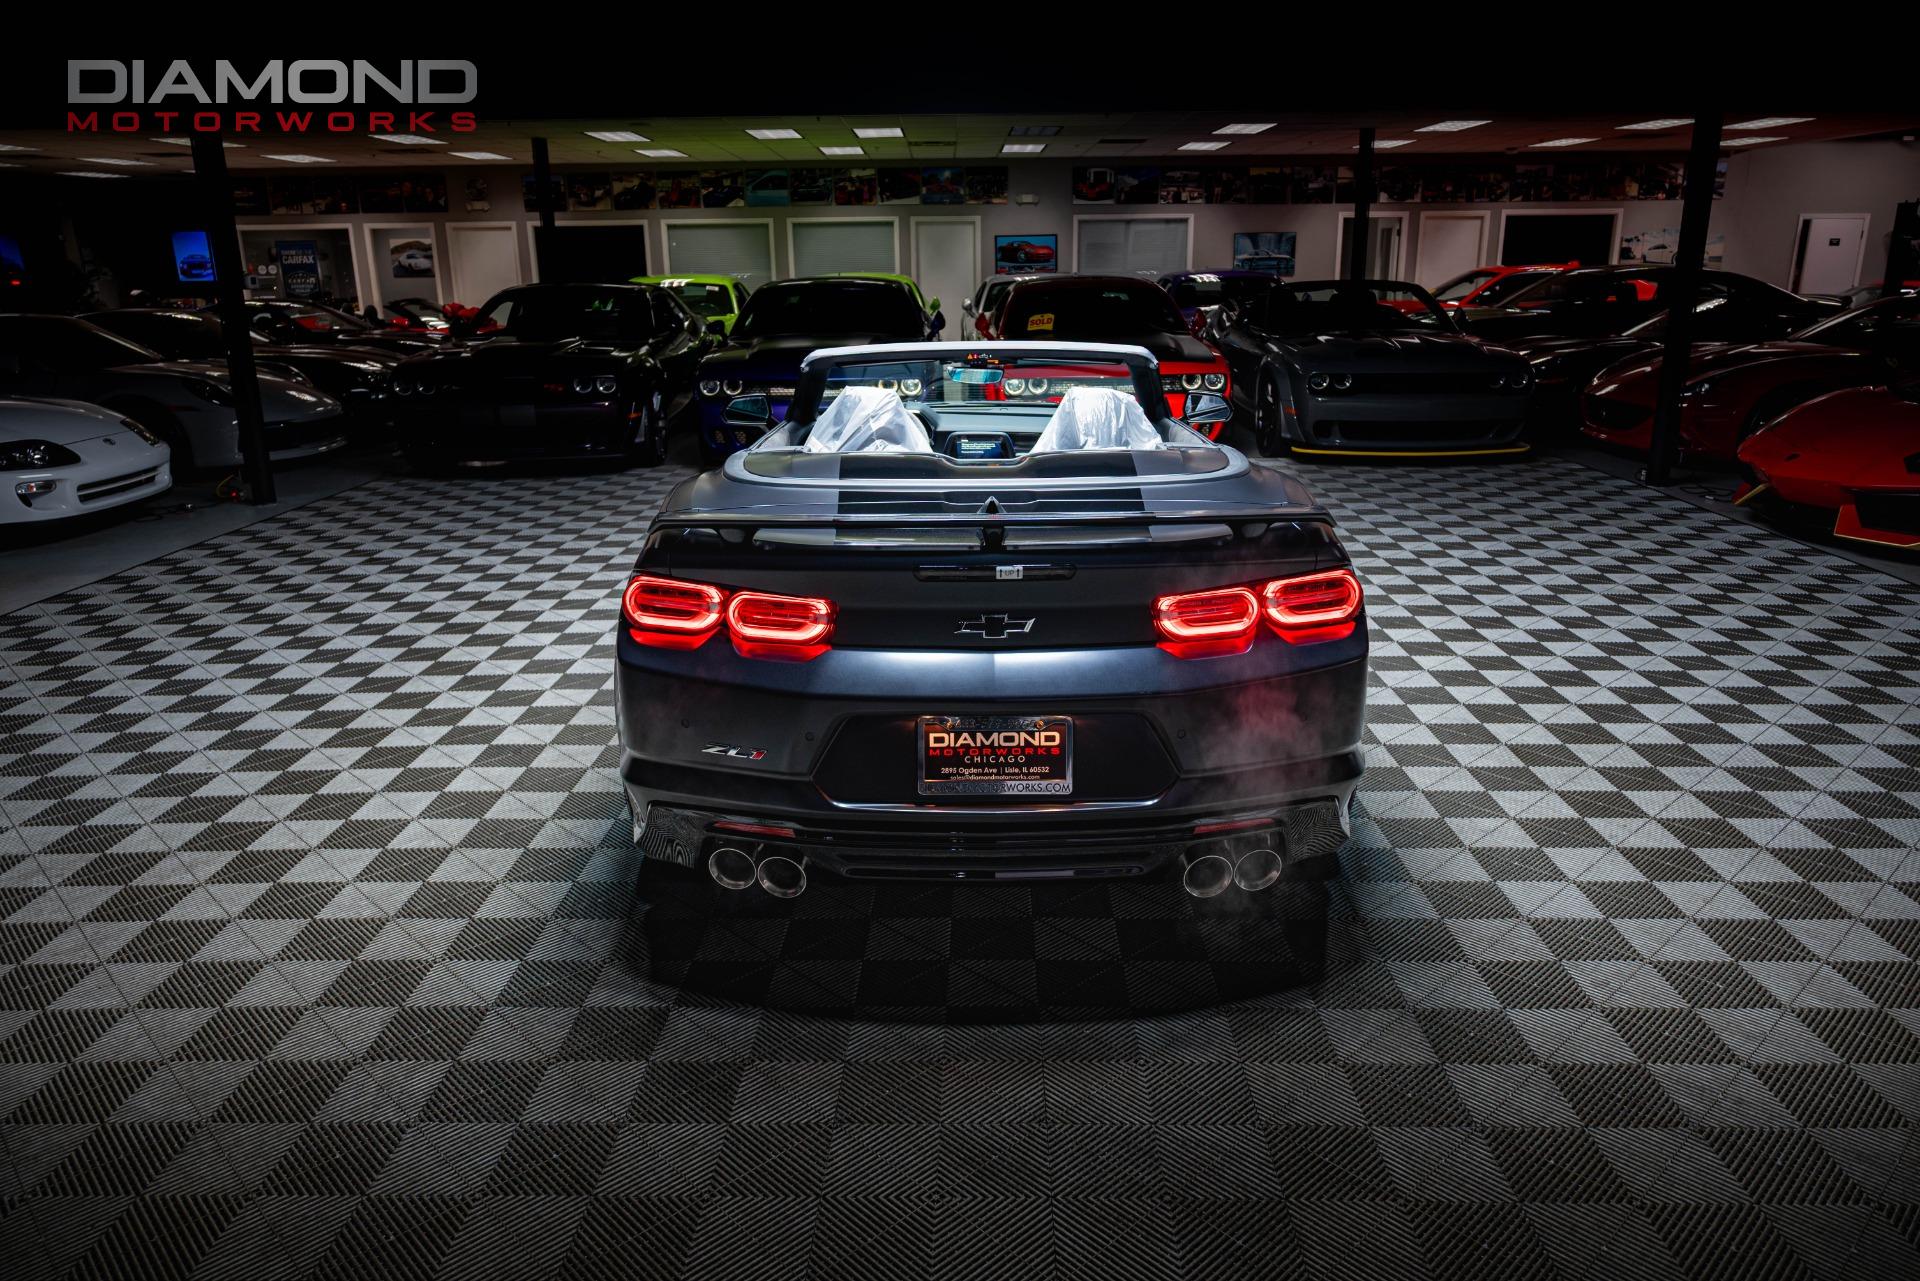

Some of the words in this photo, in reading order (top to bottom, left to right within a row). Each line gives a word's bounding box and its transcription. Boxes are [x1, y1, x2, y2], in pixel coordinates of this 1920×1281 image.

[282, 255, 314, 264] CARFAX
[1030, 317, 1053, 326] SOLD
[929, 731, 1060, 747] DIAMOND
[701, 742, 768, 760] ZL1
[929, 748, 1060, 756] MOTORWORKS
[964, 755, 1026, 764] CHICAGO
[958, 767, 982, 775] Ogden
[1004, 766, 1021, 774] Lisle,
